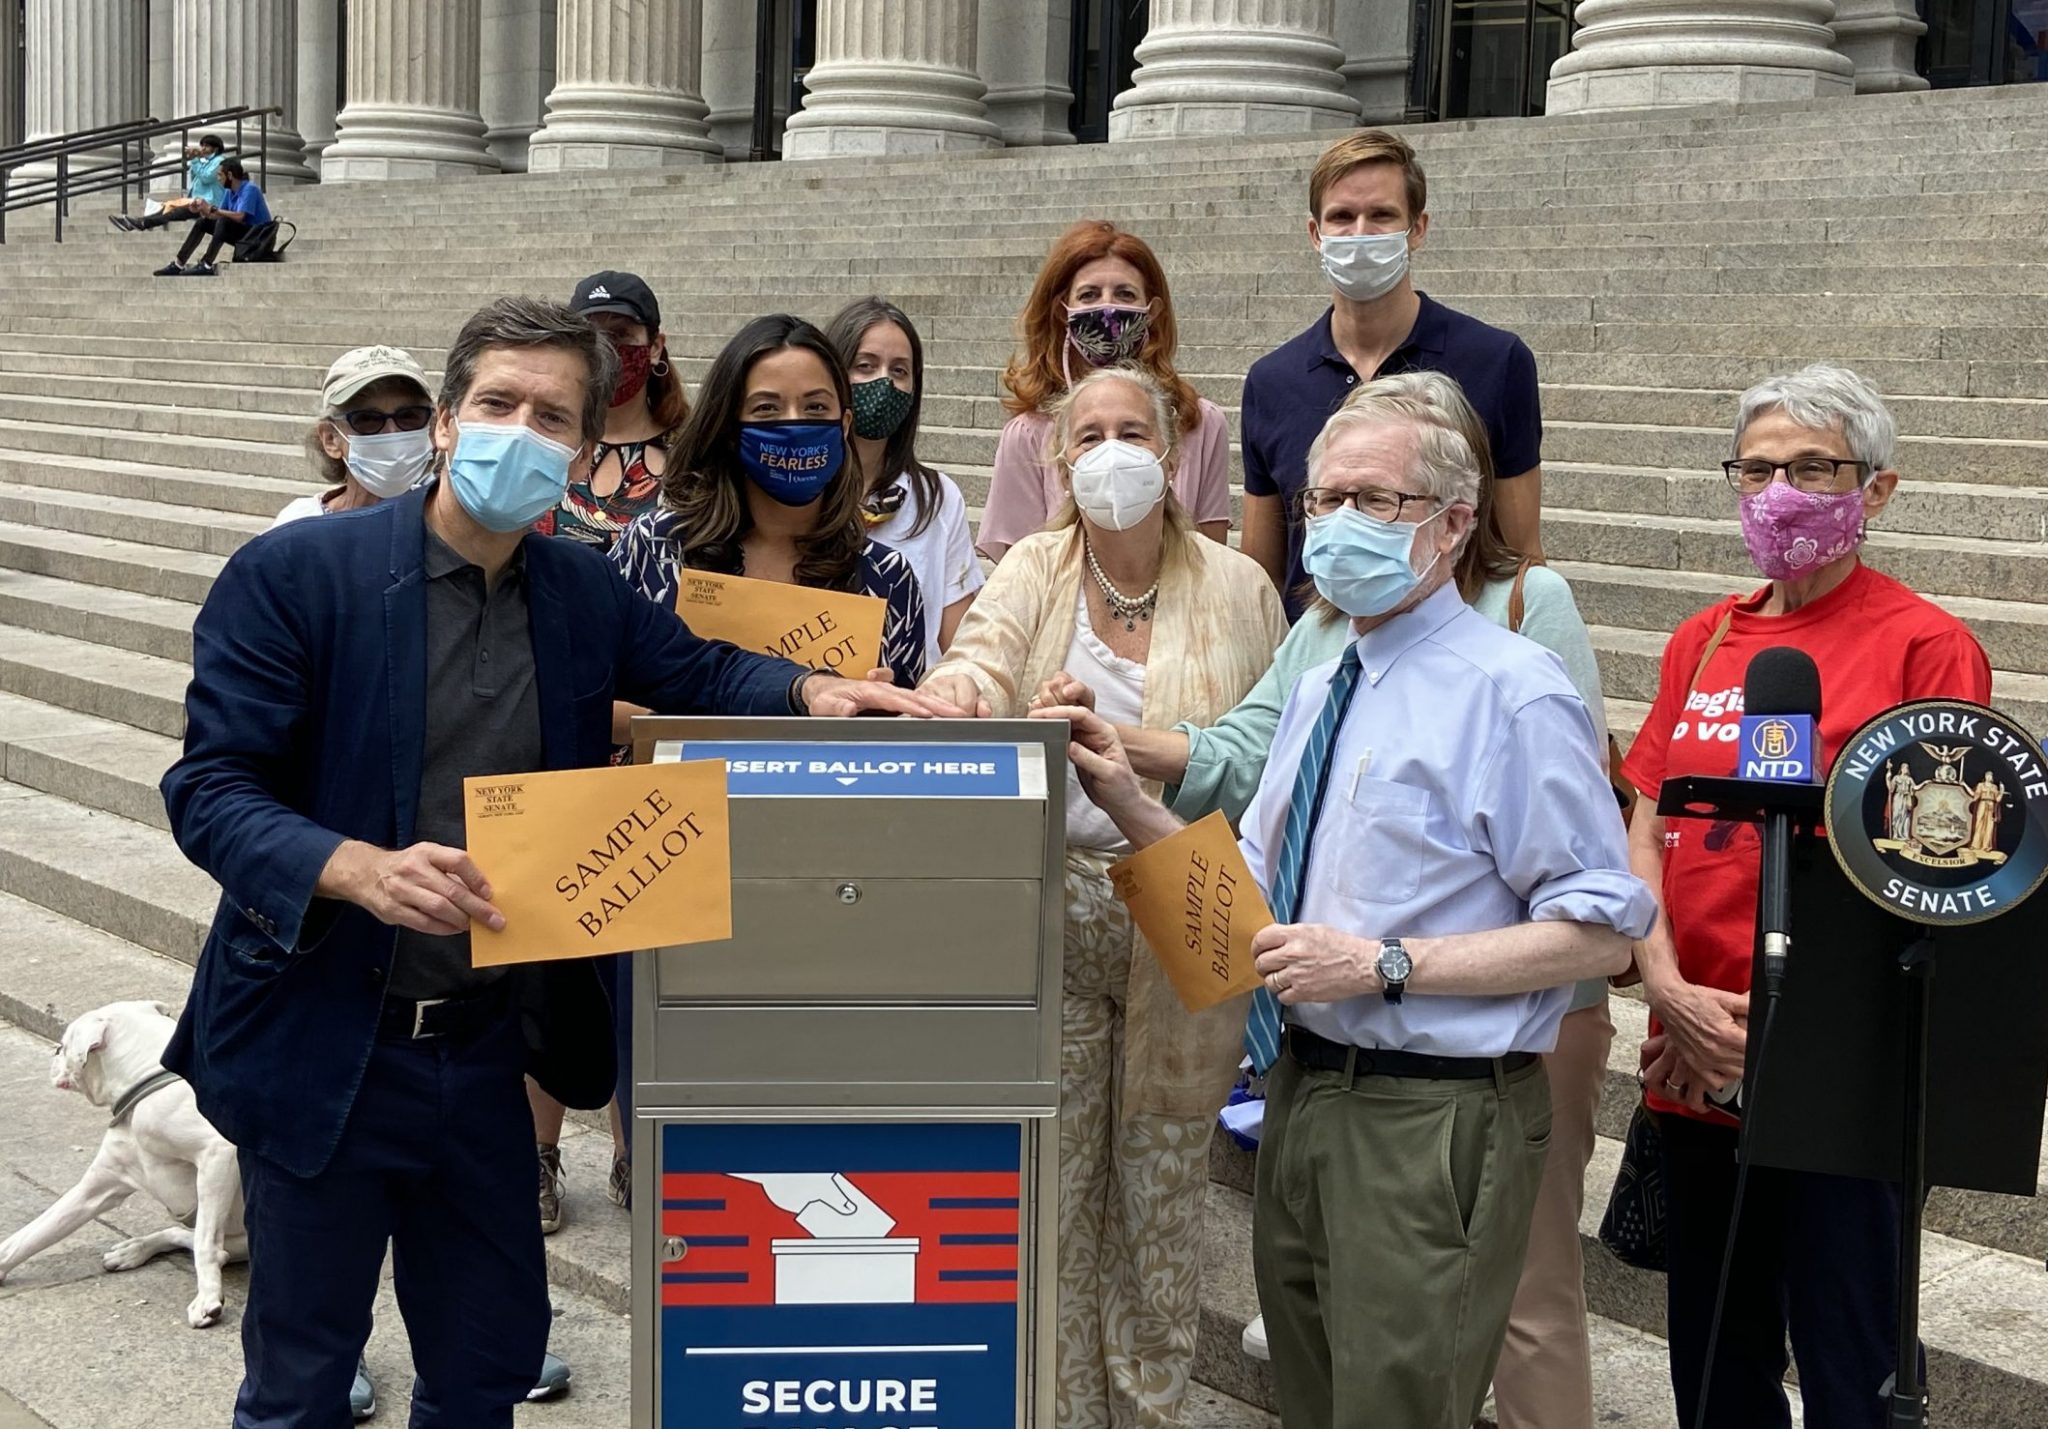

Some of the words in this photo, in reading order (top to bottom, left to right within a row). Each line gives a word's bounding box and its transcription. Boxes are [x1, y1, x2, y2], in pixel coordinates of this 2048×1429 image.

[760, 442, 788, 456] NEW
[790, 444, 829, 457] YORK'S
[760, 453, 829, 471] FEARLESS
[764, 610, 838, 659] MPLE
[726, 760, 802, 774] SERT
[808, 760, 917, 775] BALLOT
[923, 762, 996, 775] HERE
[1745, 760, 1804, 778] NTD
[1845, 725, 1896, 780] NEW
[1900, 712, 1981, 738] YORK
[1982, 726, 2048, 800] STATE
[475, 786, 496, 796] NEW
[497, 784, 524, 794] YORK
[486, 794, 514, 804] STATE
[483, 802, 518, 812] SENATE
[555, 788, 673, 902] SAMPLE
[1912, 852, 1967, 866] EXCELSIOR
[575, 811, 705, 938] BALLLOT
[1184, 849, 1209, 956] SAMPLE
[1883, 878, 1997, 914] SENATE
[1211, 863, 1237, 982] BALLLOT
[742, 1378, 938, 1414] SECURE
